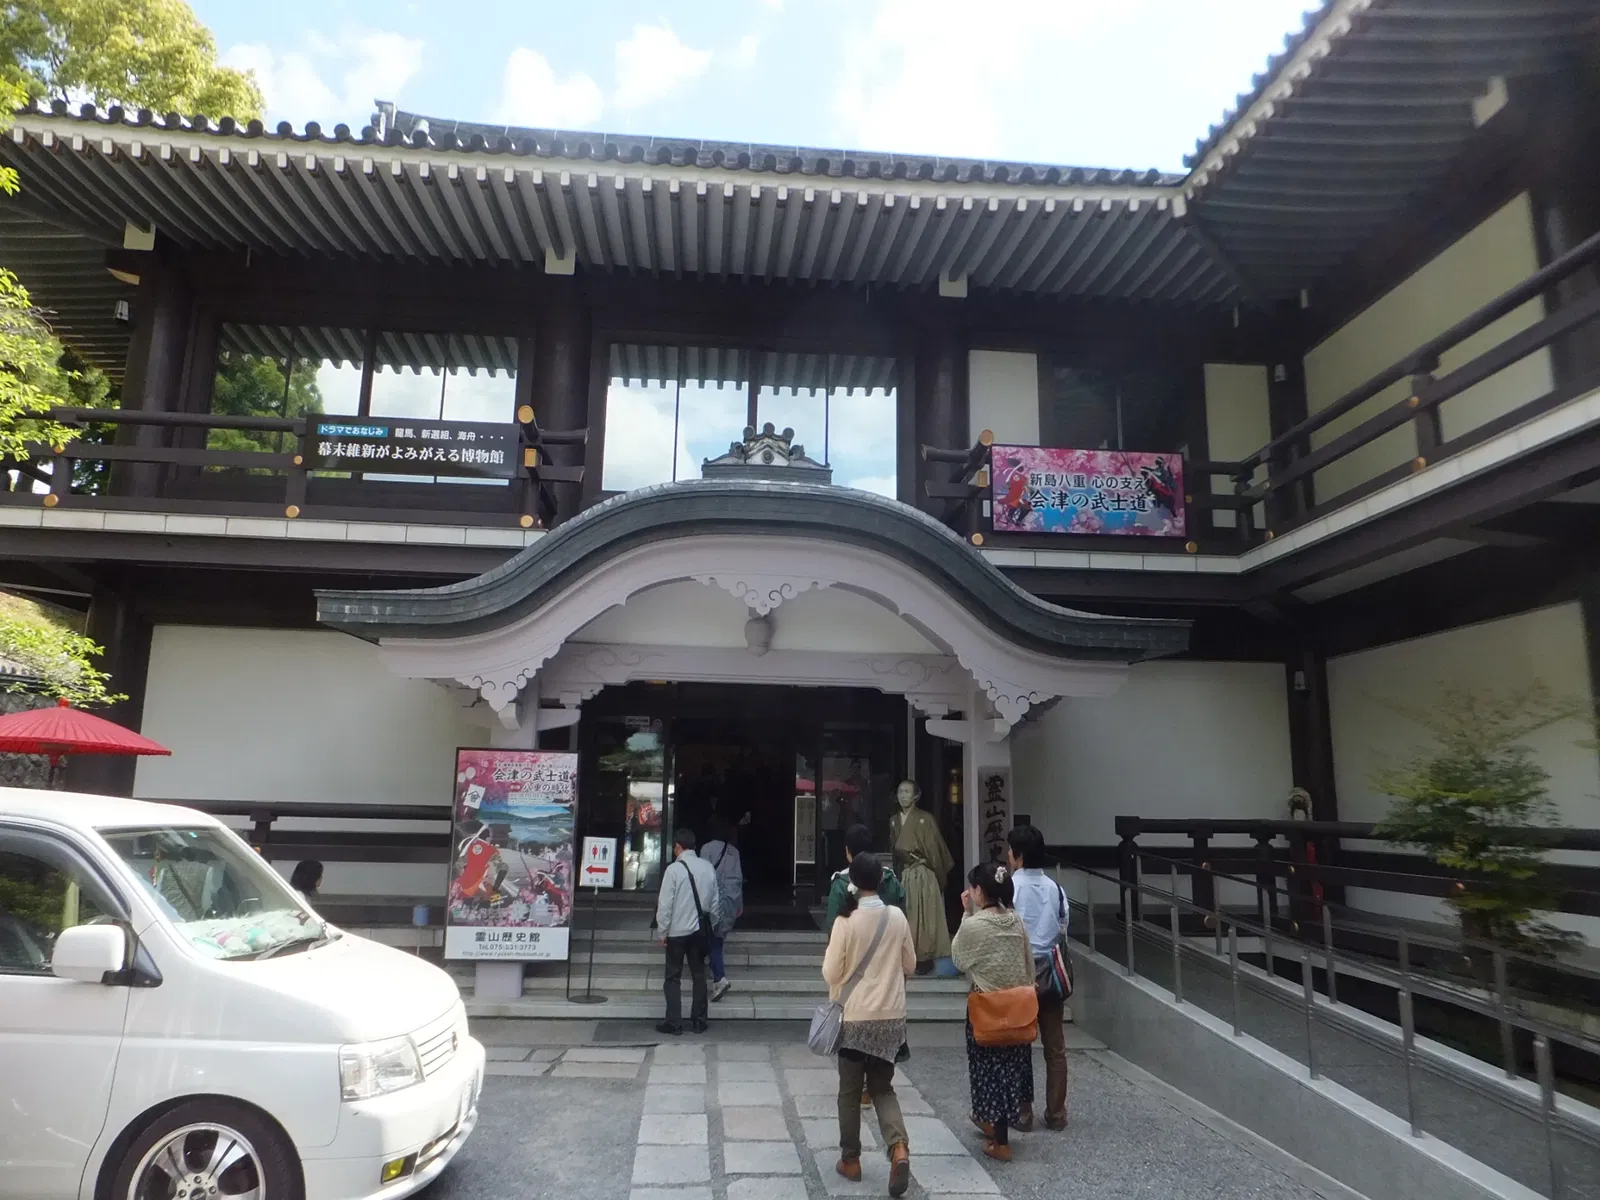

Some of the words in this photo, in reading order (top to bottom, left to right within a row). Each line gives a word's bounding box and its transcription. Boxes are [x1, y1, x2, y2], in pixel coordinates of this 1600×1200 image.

[320, 425, 384, 436] ドラマでおなじみ
[317, 441, 504, 464] 幕末維新がよみがえる博物館
[1029, 473, 1086, 487] 新島八重
[1091, 475, 1147, 490] 心の支え
[1029, 491, 1149, 513] 会津の武士道
[493, 769, 571, 783] 会津の武士道
[475, 931, 541, 943] 霊山歴史館
